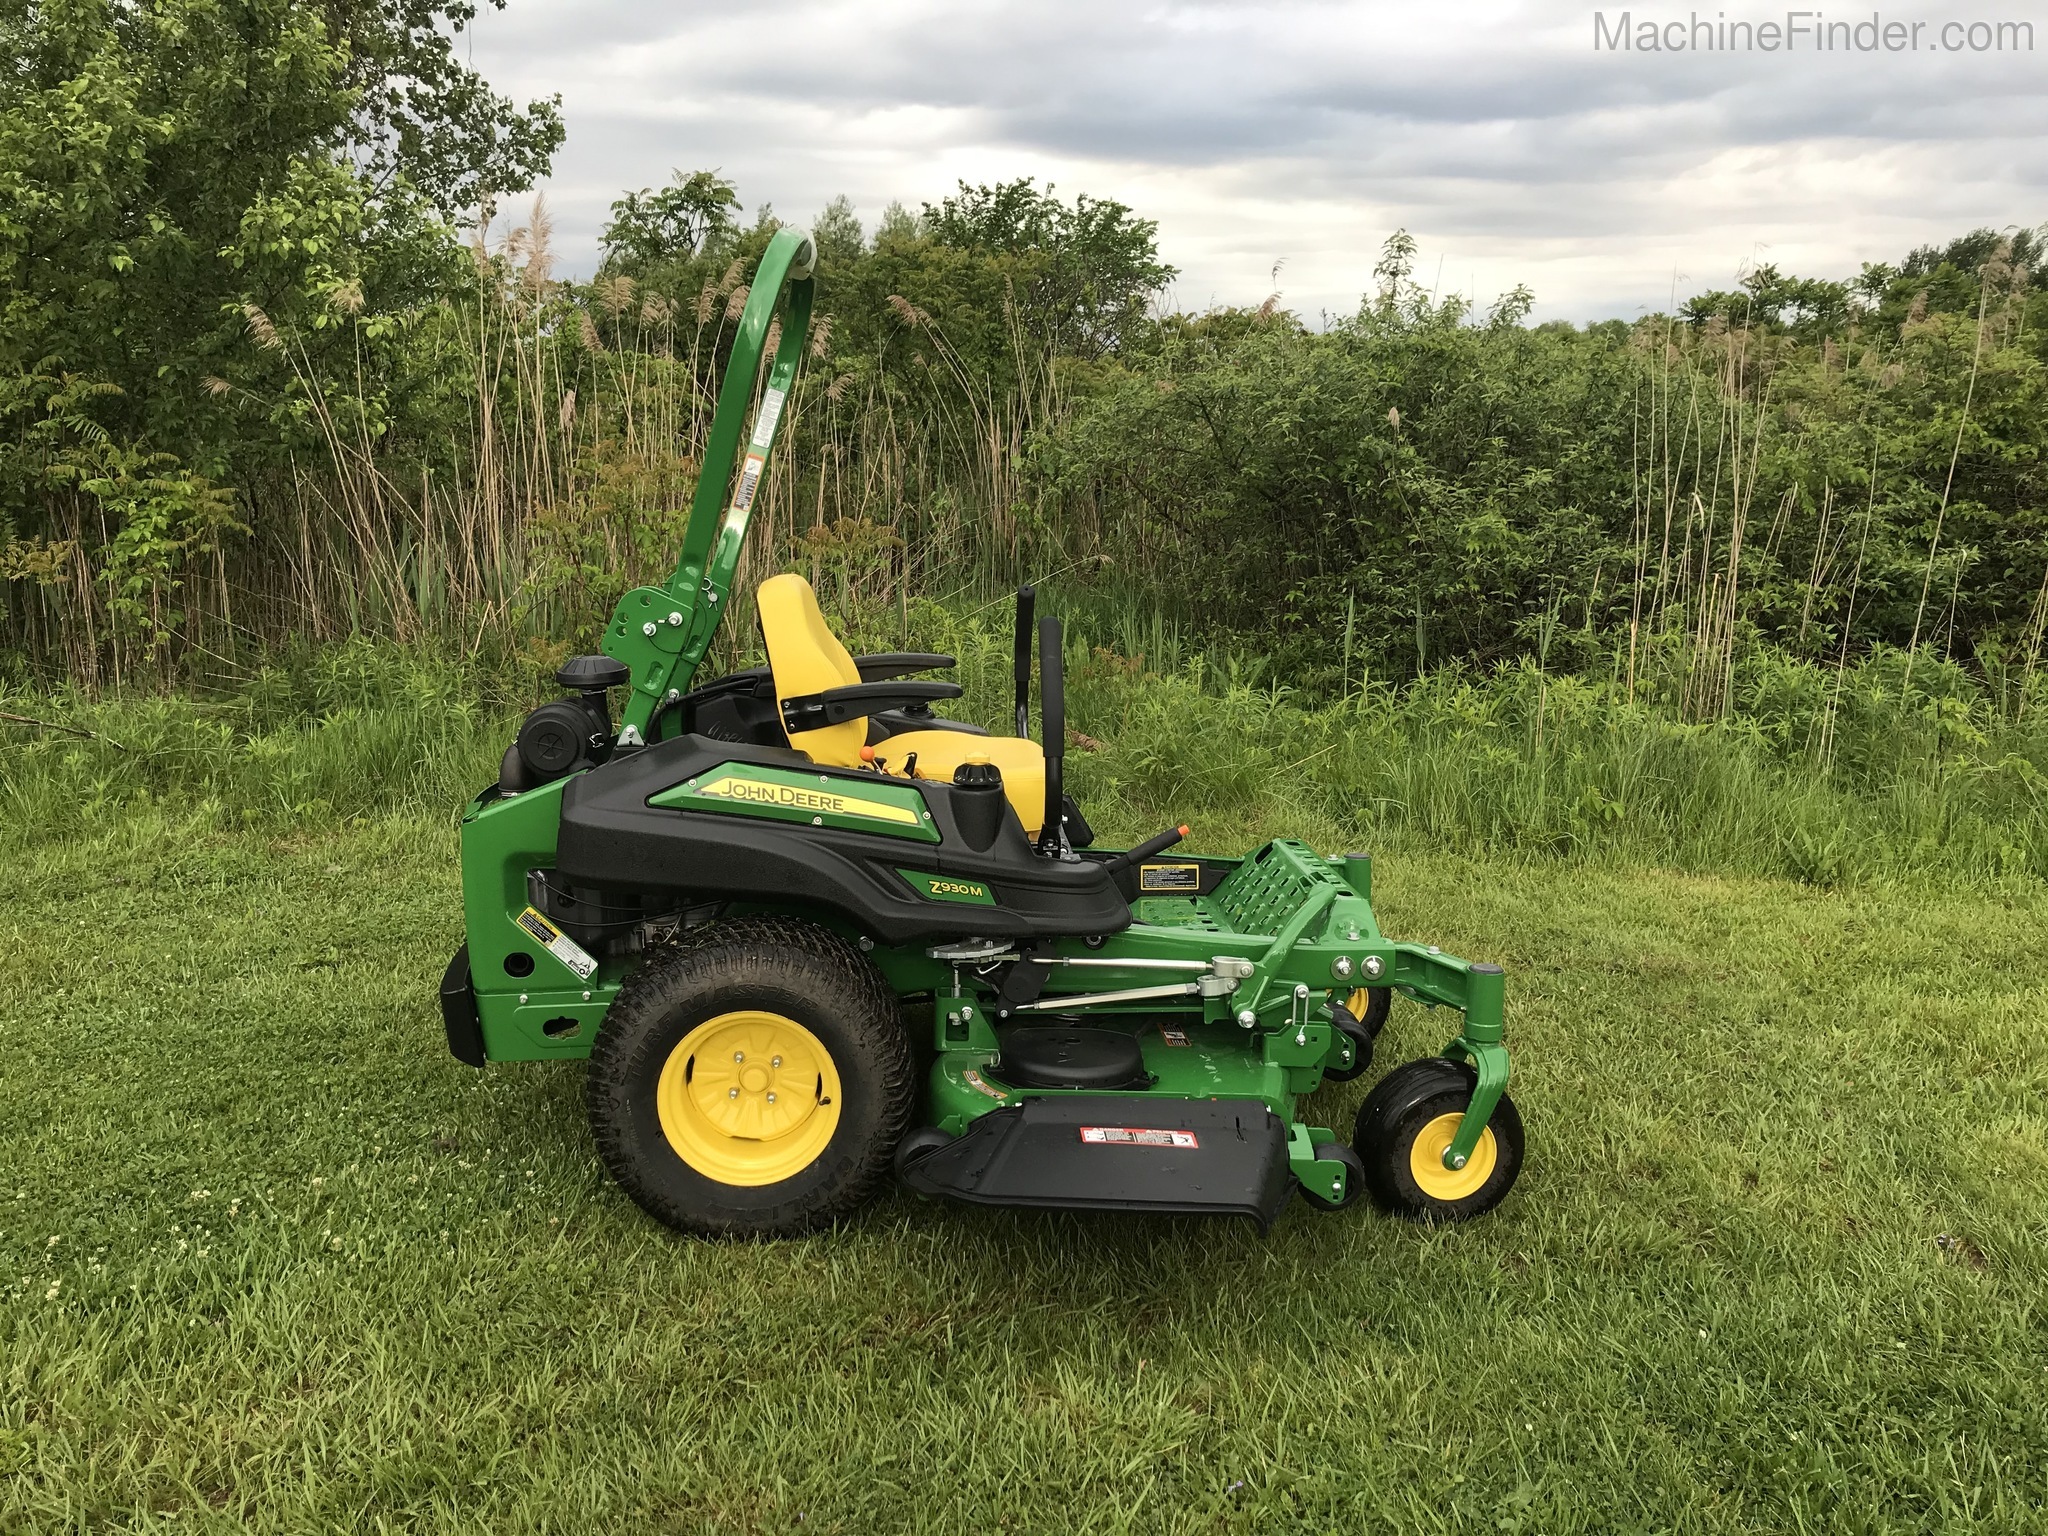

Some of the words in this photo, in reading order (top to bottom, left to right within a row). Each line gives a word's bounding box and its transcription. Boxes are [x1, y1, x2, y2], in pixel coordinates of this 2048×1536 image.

[721, 780, 774, 802] JOHN
[780, 788, 844, 811] DEERE
[679, 982, 819, 1018] MASTER
